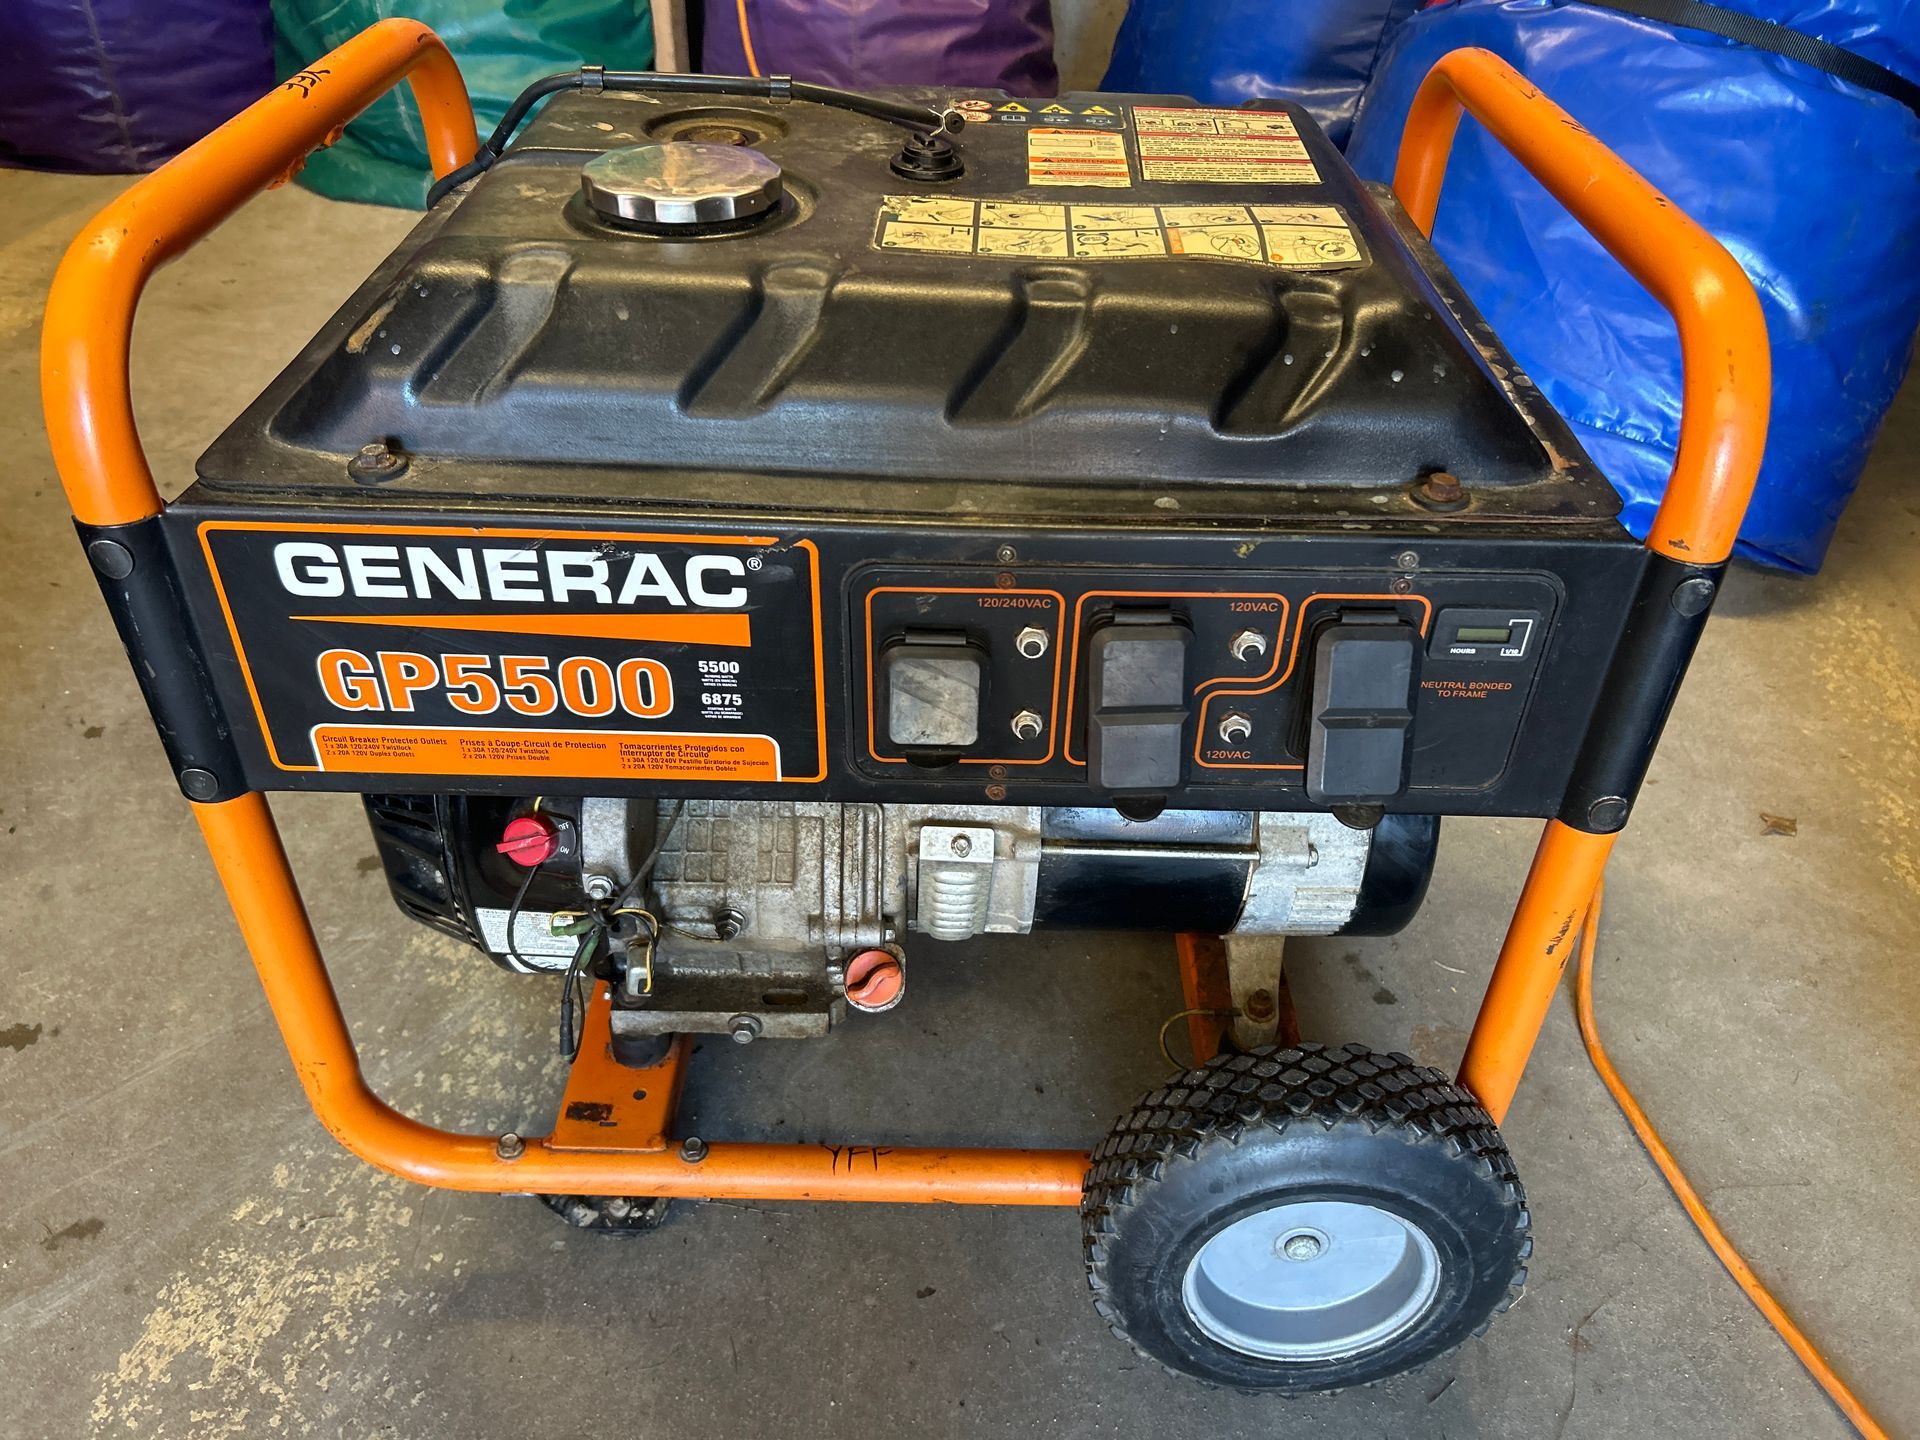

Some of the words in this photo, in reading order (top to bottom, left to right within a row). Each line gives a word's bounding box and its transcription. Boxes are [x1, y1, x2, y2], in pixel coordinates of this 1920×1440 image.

[977, 597, 1052, 609] 120/240VAC
[1230, 602, 1279, 613] 120VAC
[698, 660, 740, 674] 5500
[316, 648, 676, 719] GP5500
[1421, 681, 1467, 689] NEUTRAL
[1469, 681, 1512, 690] BONDED
[701, 692, 743, 706] 6875
[1437, 690, 1451, 698] TO
[1452, 690, 1488, 699] FRAME
[322, 735, 347, 743] Circuit
[350, 736, 379, 744] Breaker
[381, 736, 418, 744] Protected
[459, 738, 485, 747] Prises
[495, 739, 550, 748] Coupe-Circuit
[553, 740, 563, 748] de
[565, 741, 607, 749] Protection
[619, 742, 683, 752] Tomacorrientes
[684, 744, 728, 753] Protegidos
[620, 749, 663, 758] Interruptor
[665, 750, 676, 758] de
[677, 750, 709, 758] Circuito
[1206, 750, 1251, 760] 120VAC
[558, 821, 569, 831] OFF
[559, 845, 570, 855] ON
